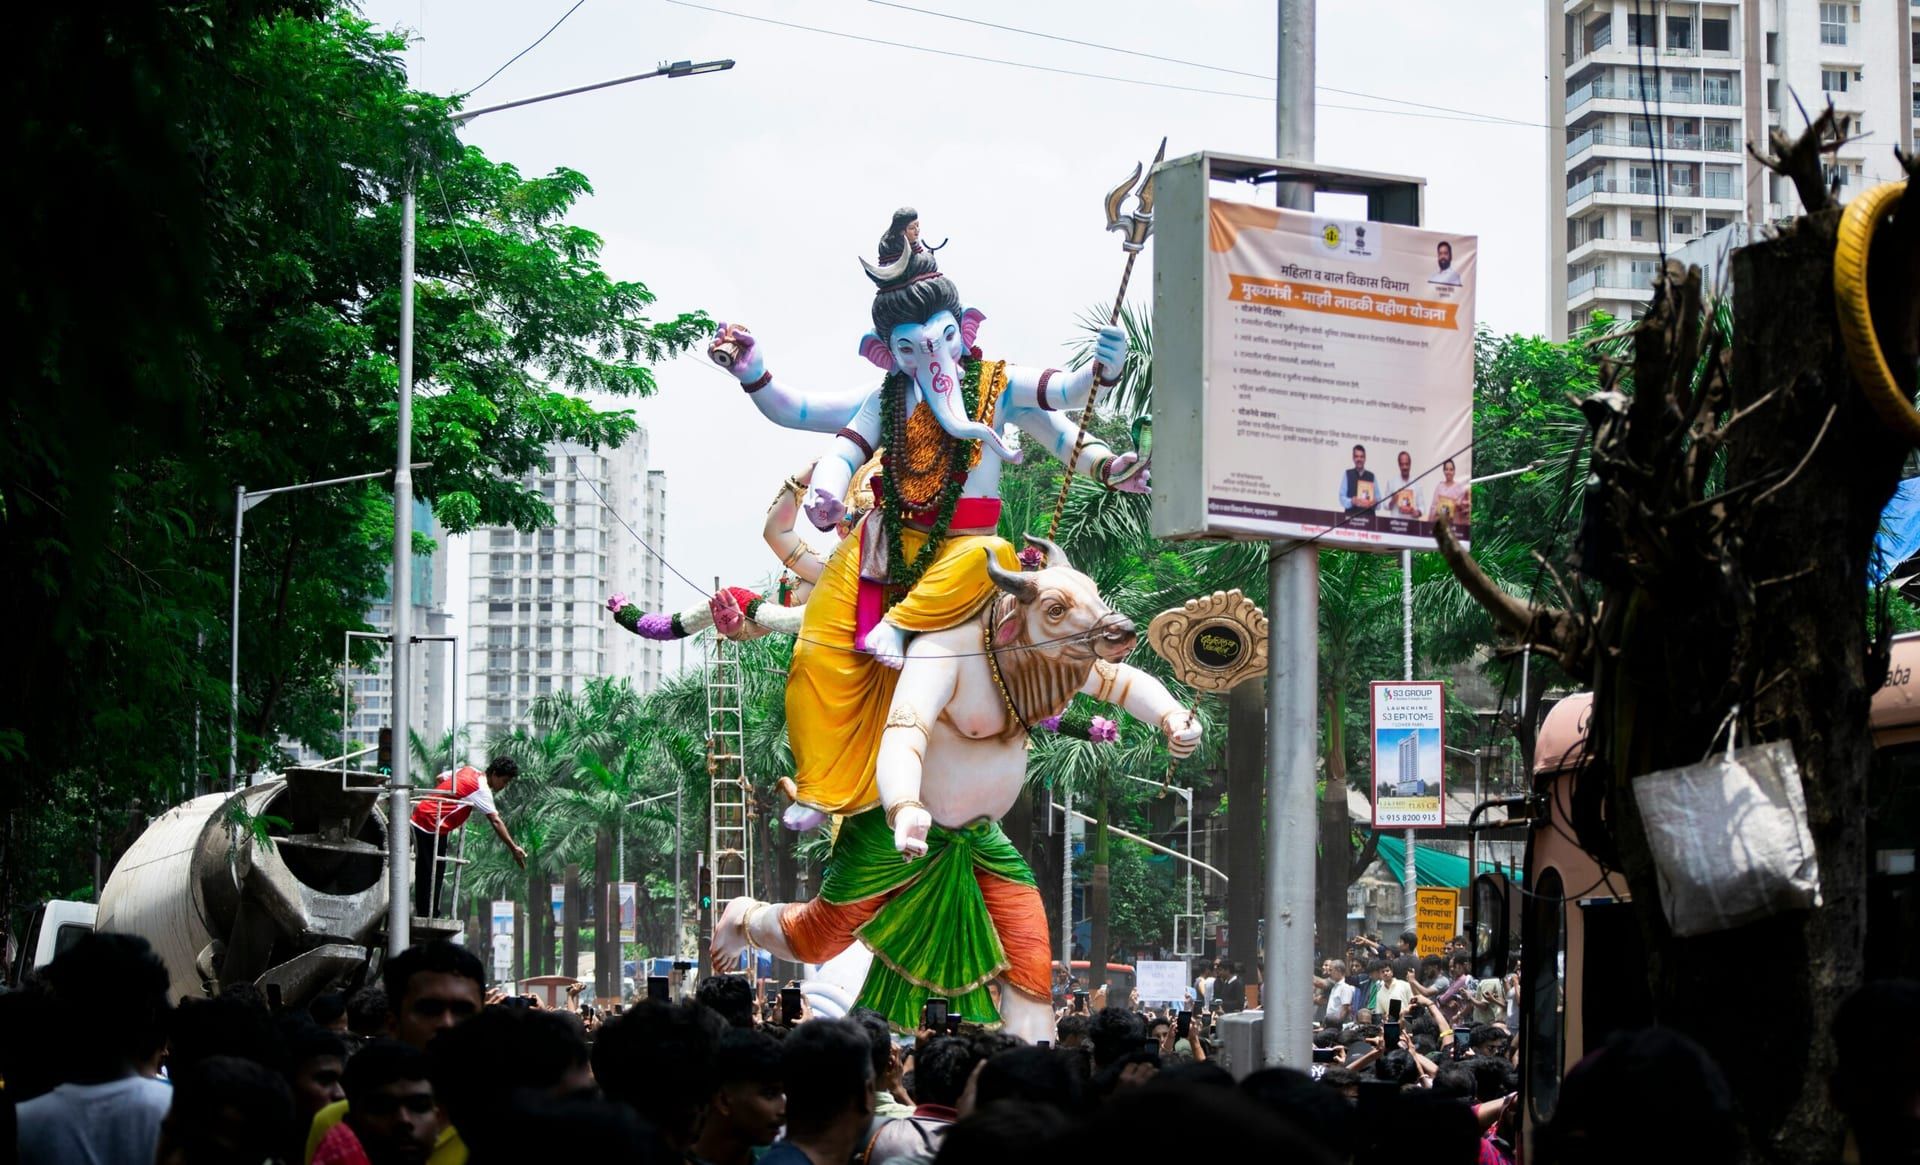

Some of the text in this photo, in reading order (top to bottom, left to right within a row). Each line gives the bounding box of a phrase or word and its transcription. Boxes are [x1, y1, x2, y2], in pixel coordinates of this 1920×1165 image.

[1281, 263, 1410, 292] महिला व बाल विकास विभाग
[1241, 282, 1291, 301] मुख्यमंत्री
[1302, 290, 1332, 308] माझी
[1333, 294, 1373, 313] लाडकी
[1375, 299, 1408, 317] बहीण
[1409, 301, 1447, 321] योजना
[1393, 689, 1433, 697] S3 GROUP
[1382, 712, 1393, 721] S3
[1421, 934, 1446, 943] Avoid
